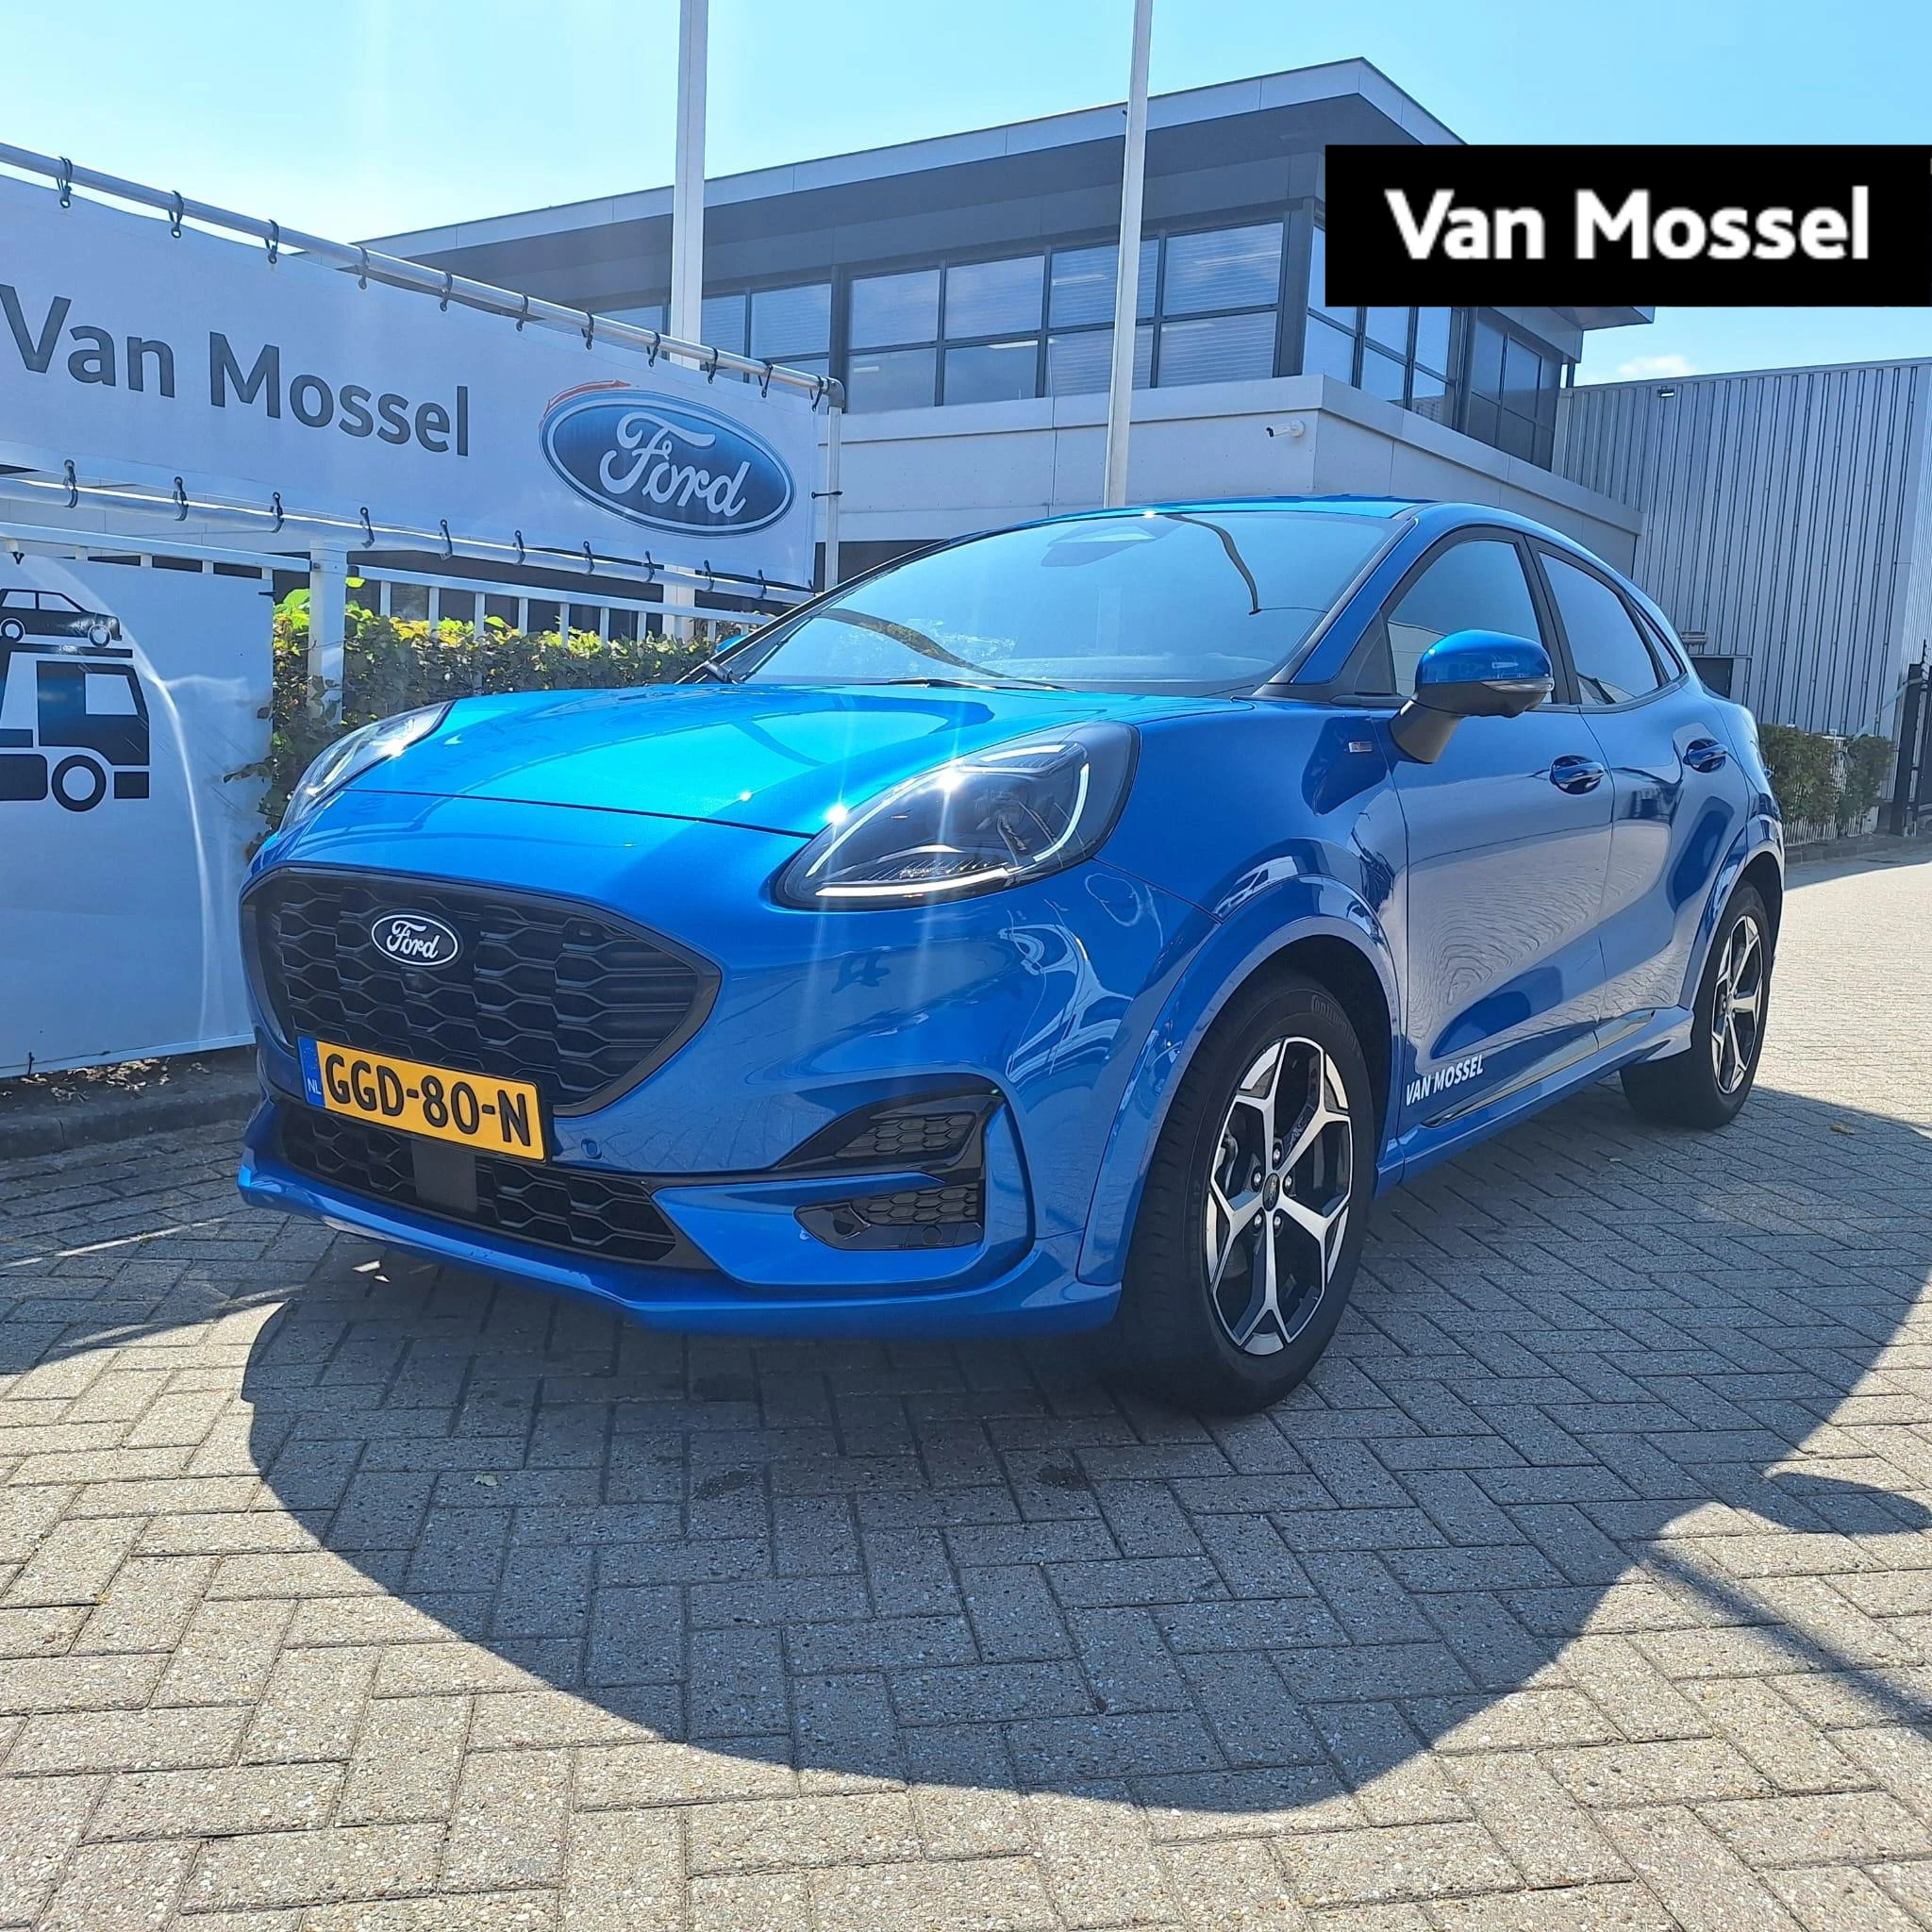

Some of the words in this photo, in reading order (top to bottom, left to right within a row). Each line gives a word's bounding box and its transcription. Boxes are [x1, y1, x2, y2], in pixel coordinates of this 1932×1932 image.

[0, 283, 175, 398] Van
[208, 331, 469, 457] Mossel
[599, 411, 751, 517] Ford
[386, 920, 441, 959] Ford
[307, 1077, 322, 1095] NL
[325, 1053, 532, 1148] GGD-80-N
[1406, 1075, 1431, 1107] VAN
[1433, 1054, 1484, 1093] MOSSEL
